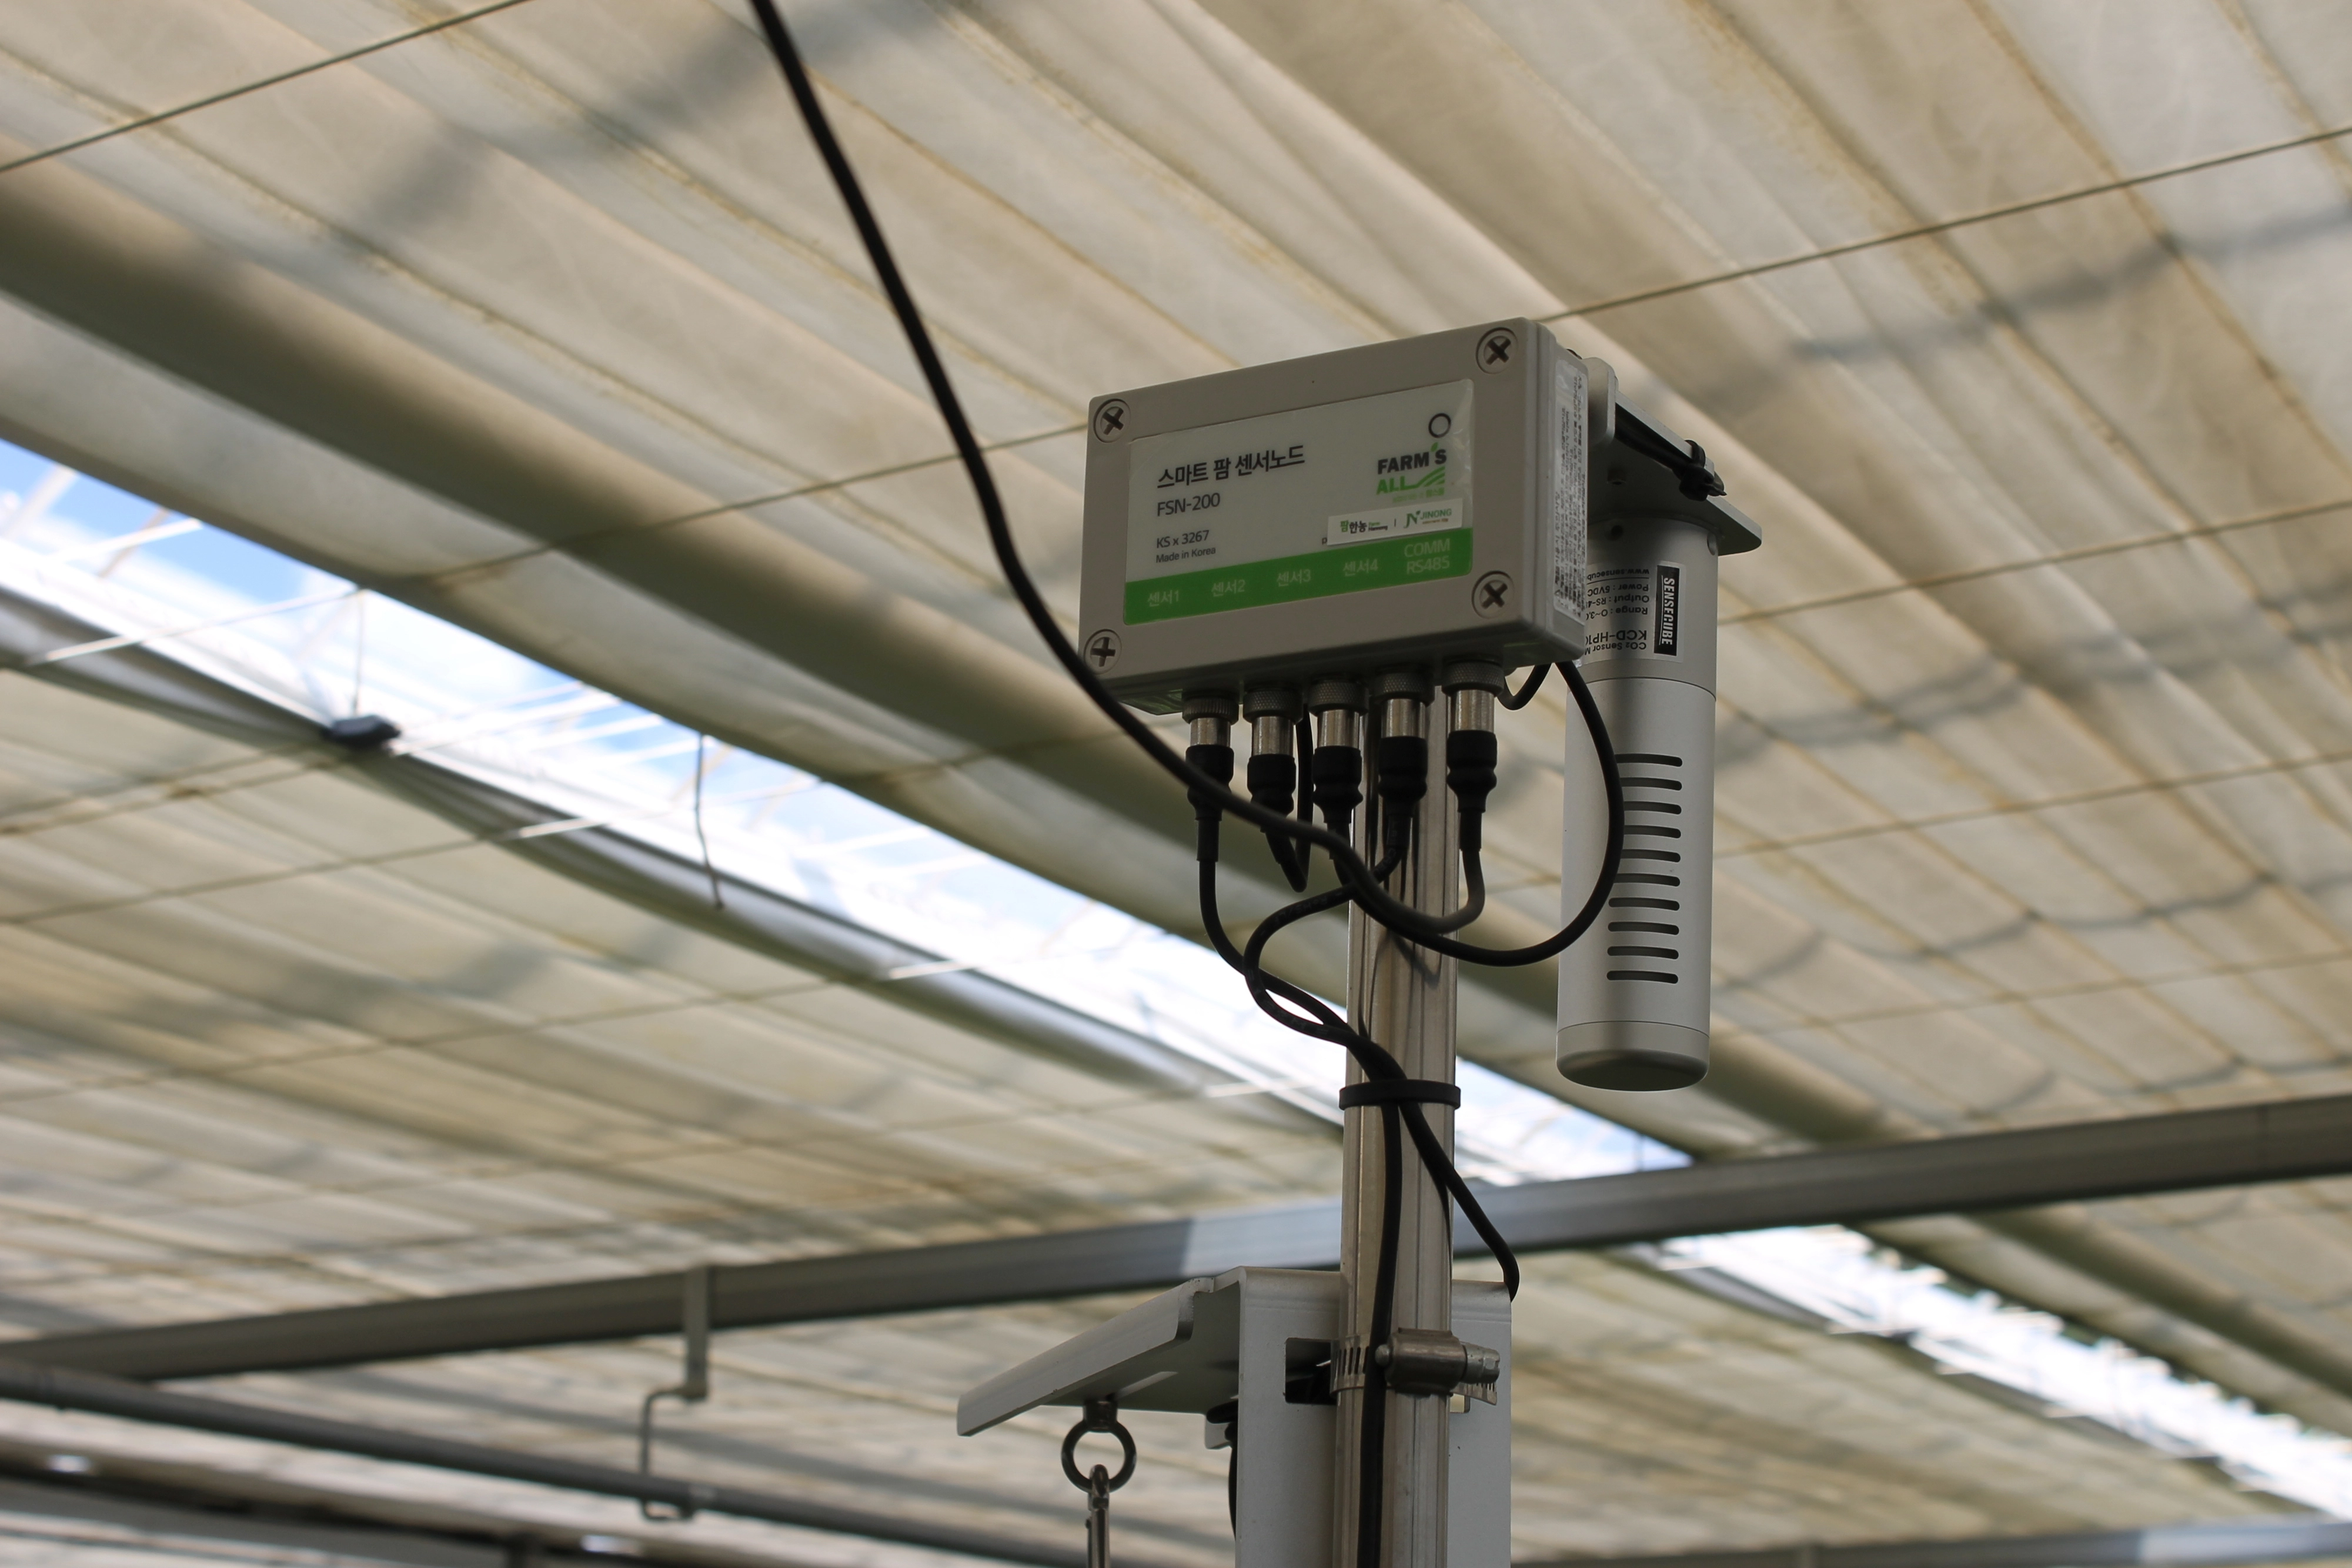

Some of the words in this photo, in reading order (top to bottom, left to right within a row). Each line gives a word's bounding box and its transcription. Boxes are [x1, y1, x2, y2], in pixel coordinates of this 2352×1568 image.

[1157, 462, 1209, 489] 스마트
[1212, 457, 1231, 481] 팜
[1234, 445, 1305, 476] 센서노드
[1157, 493, 1221, 516] FSN-200
[1420, 508, 1452, 520] JINONG
[1340, 519, 1367, 534] 팜한농
[1156, 536, 1171, 549] KS
[1181, 530, 1210, 545] 3267
[1404, 538, 1451, 557] COMM
[1156, 552, 1180, 563] Made
[1181, 550, 1189, 559] in
[1191, 546, 1216, 558] Korea
[1342, 559, 1378, 577] 센서4
[1406, 556, 1451, 575] RS485
[1276, 569, 1312, 587] 센서3
[1211, 579, 1246, 597] 센서2
[1588, 586, 1611, 597] 5VDC
[1147, 590, 1180, 607] 센서1
[1586, 597, 1606, 608] RS-4
[1613, 594, 1649, 603] Output
[1615, 606, 1648, 615] Range
[1661, 577, 1675, 646] SENSECUBE
[1592, 641, 1622, 652] Sensor
